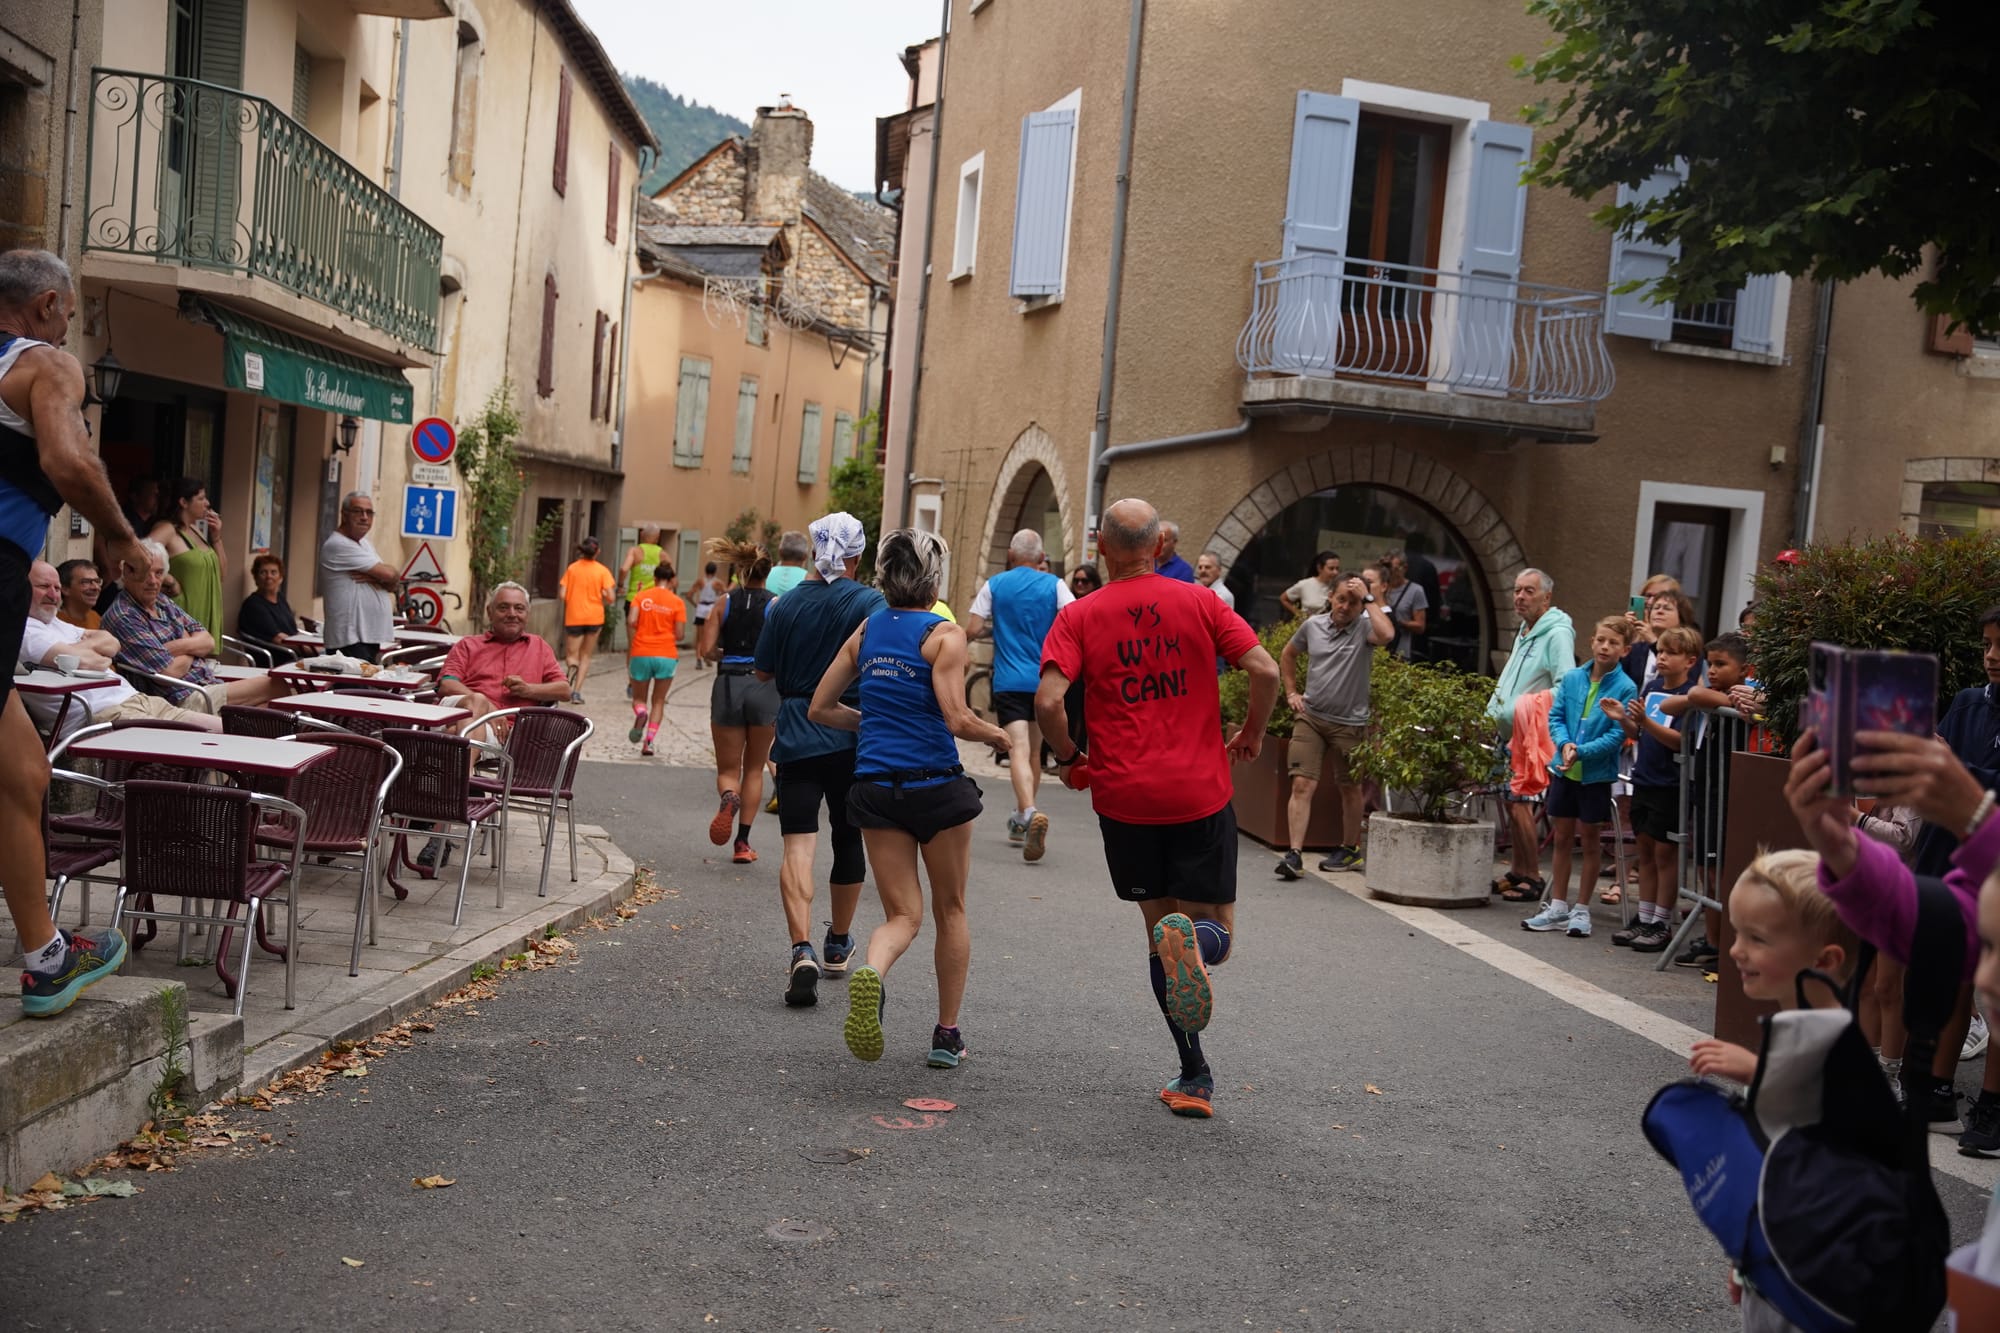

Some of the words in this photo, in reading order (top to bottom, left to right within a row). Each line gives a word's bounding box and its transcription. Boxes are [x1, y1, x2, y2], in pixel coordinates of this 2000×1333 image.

[861, 656, 895, 673] MACADAM
[895, 660, 917, 678] CLUB
[1121, 668, 1188, 705] CAN!
